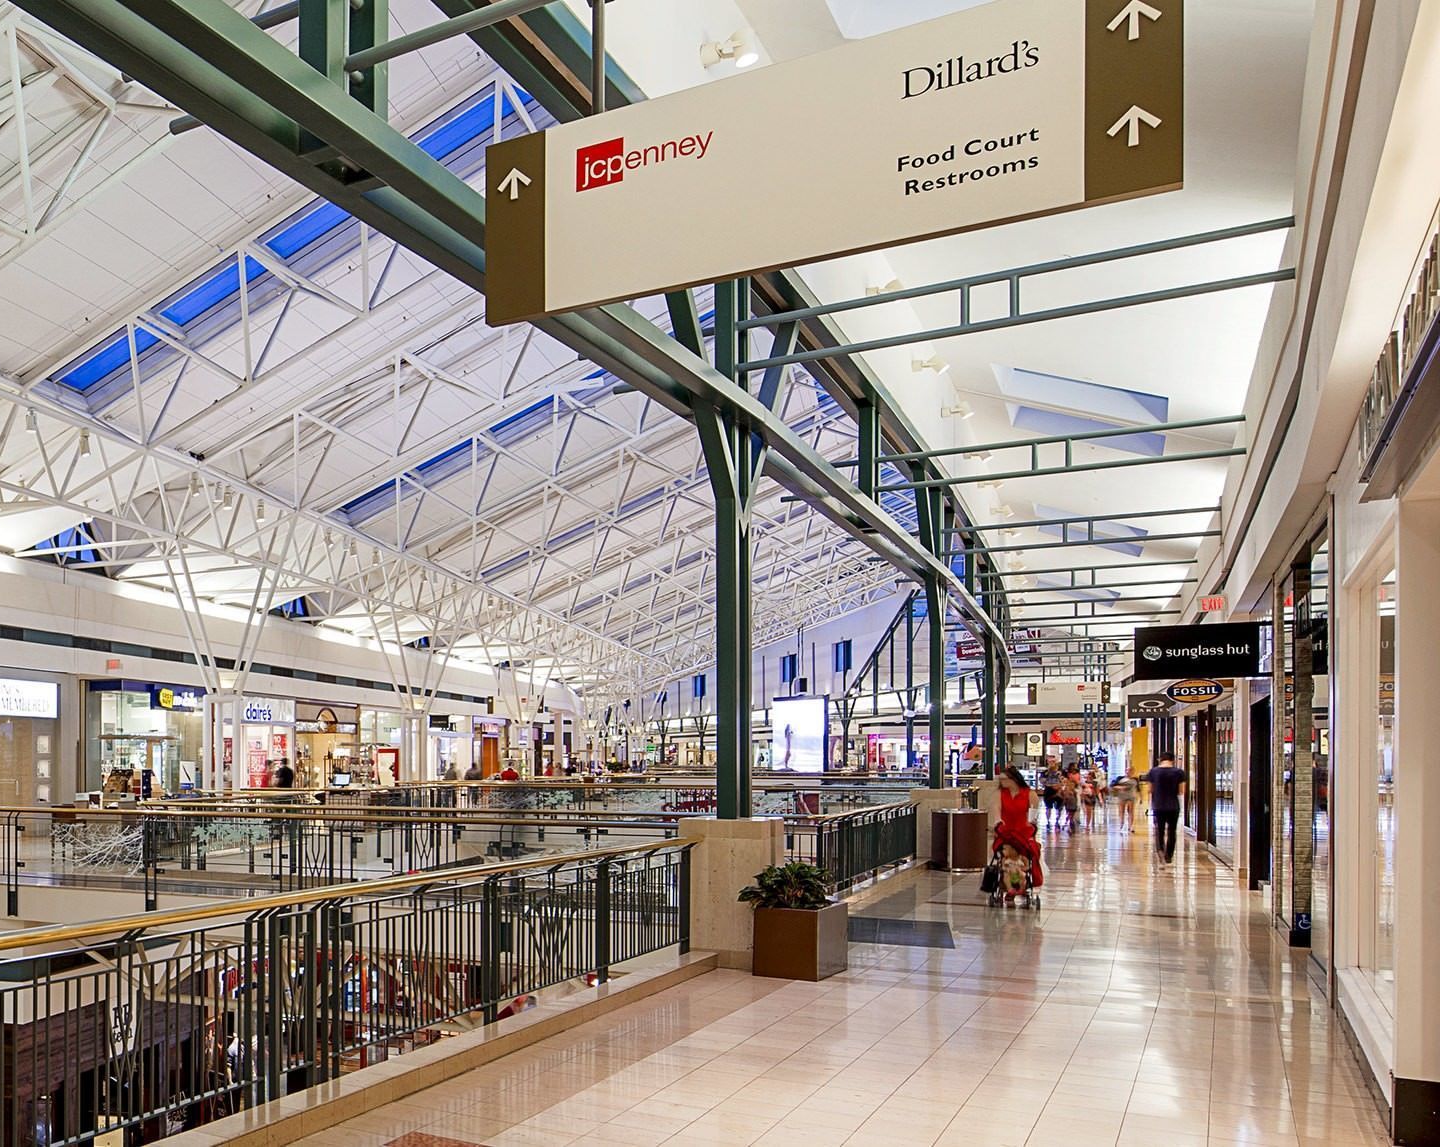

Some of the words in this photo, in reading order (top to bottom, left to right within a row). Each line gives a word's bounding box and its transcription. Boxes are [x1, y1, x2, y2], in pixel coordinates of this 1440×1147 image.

[900, 40, 1040, 100] Dillard's
[580, 131, 714, 189] jcpenney
[897, 145, 955, 172] Food
[964, 128, 1040, 156] Court
[904, 156, 1039, 196] Restrooms
[1165, 644, 1224, 660] sunglass
[1226, 643, 1251, 655] hut
[1173, 686, 1219, 696] FOSSIL
[245, 703, 273, 721] claire's
